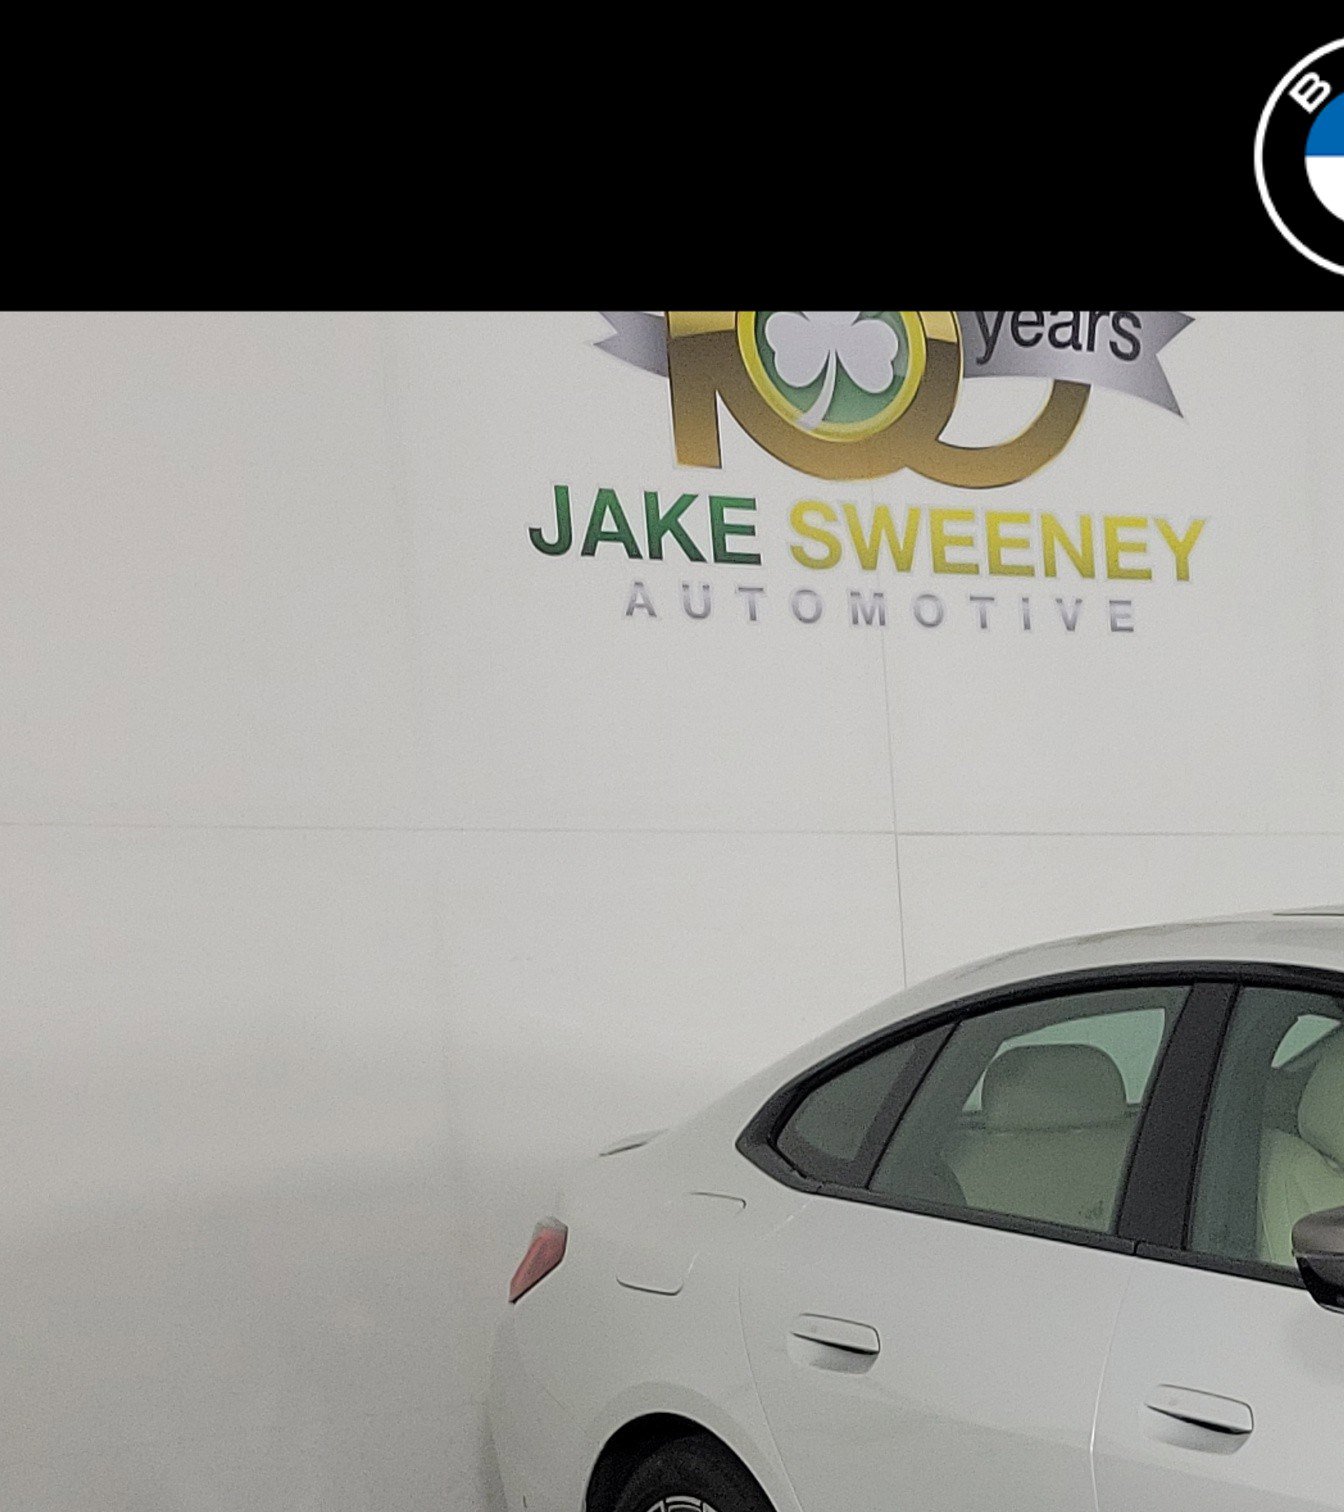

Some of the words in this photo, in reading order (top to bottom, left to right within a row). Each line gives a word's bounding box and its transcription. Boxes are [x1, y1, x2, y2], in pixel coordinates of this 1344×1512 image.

[973, 311, 1142, 366] years
[528, 485, 763, 566] JAKE
[788, 500, 1208, 582] SWEENEY
[624, 581, 1136, 633] AUTOMOTIVE
